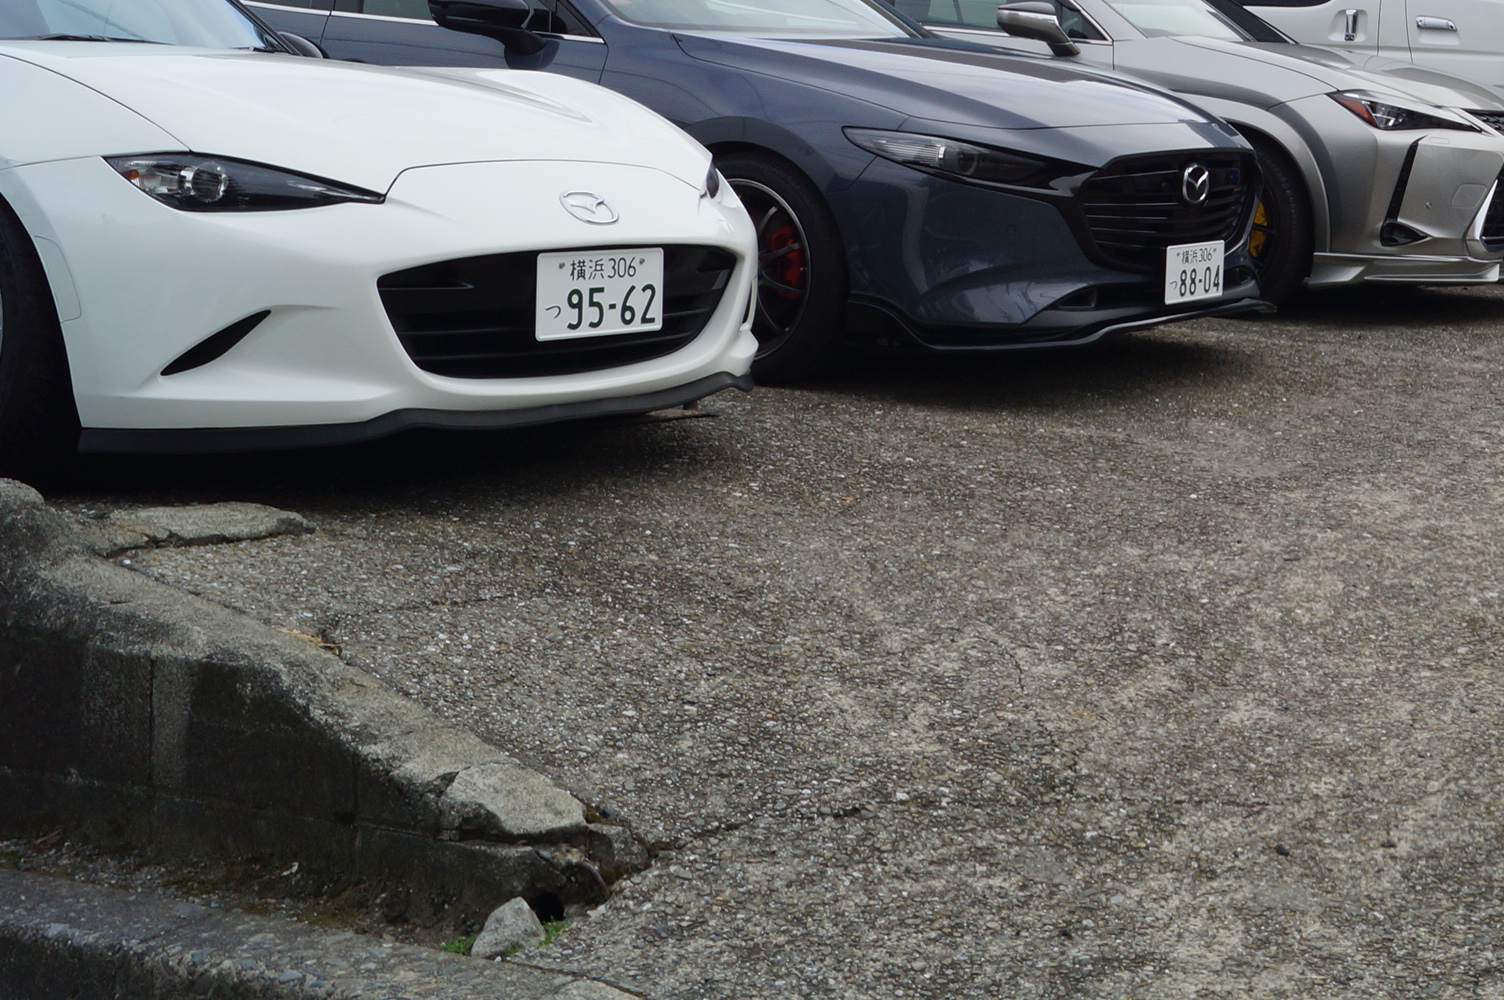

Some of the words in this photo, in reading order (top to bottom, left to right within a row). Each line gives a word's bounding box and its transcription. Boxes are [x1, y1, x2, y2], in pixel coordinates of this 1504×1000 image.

[1179, 264, 1220, 297] 88-04
[545, 305, 562, 319] つ
[566, 283, 657, 331] 95-62
